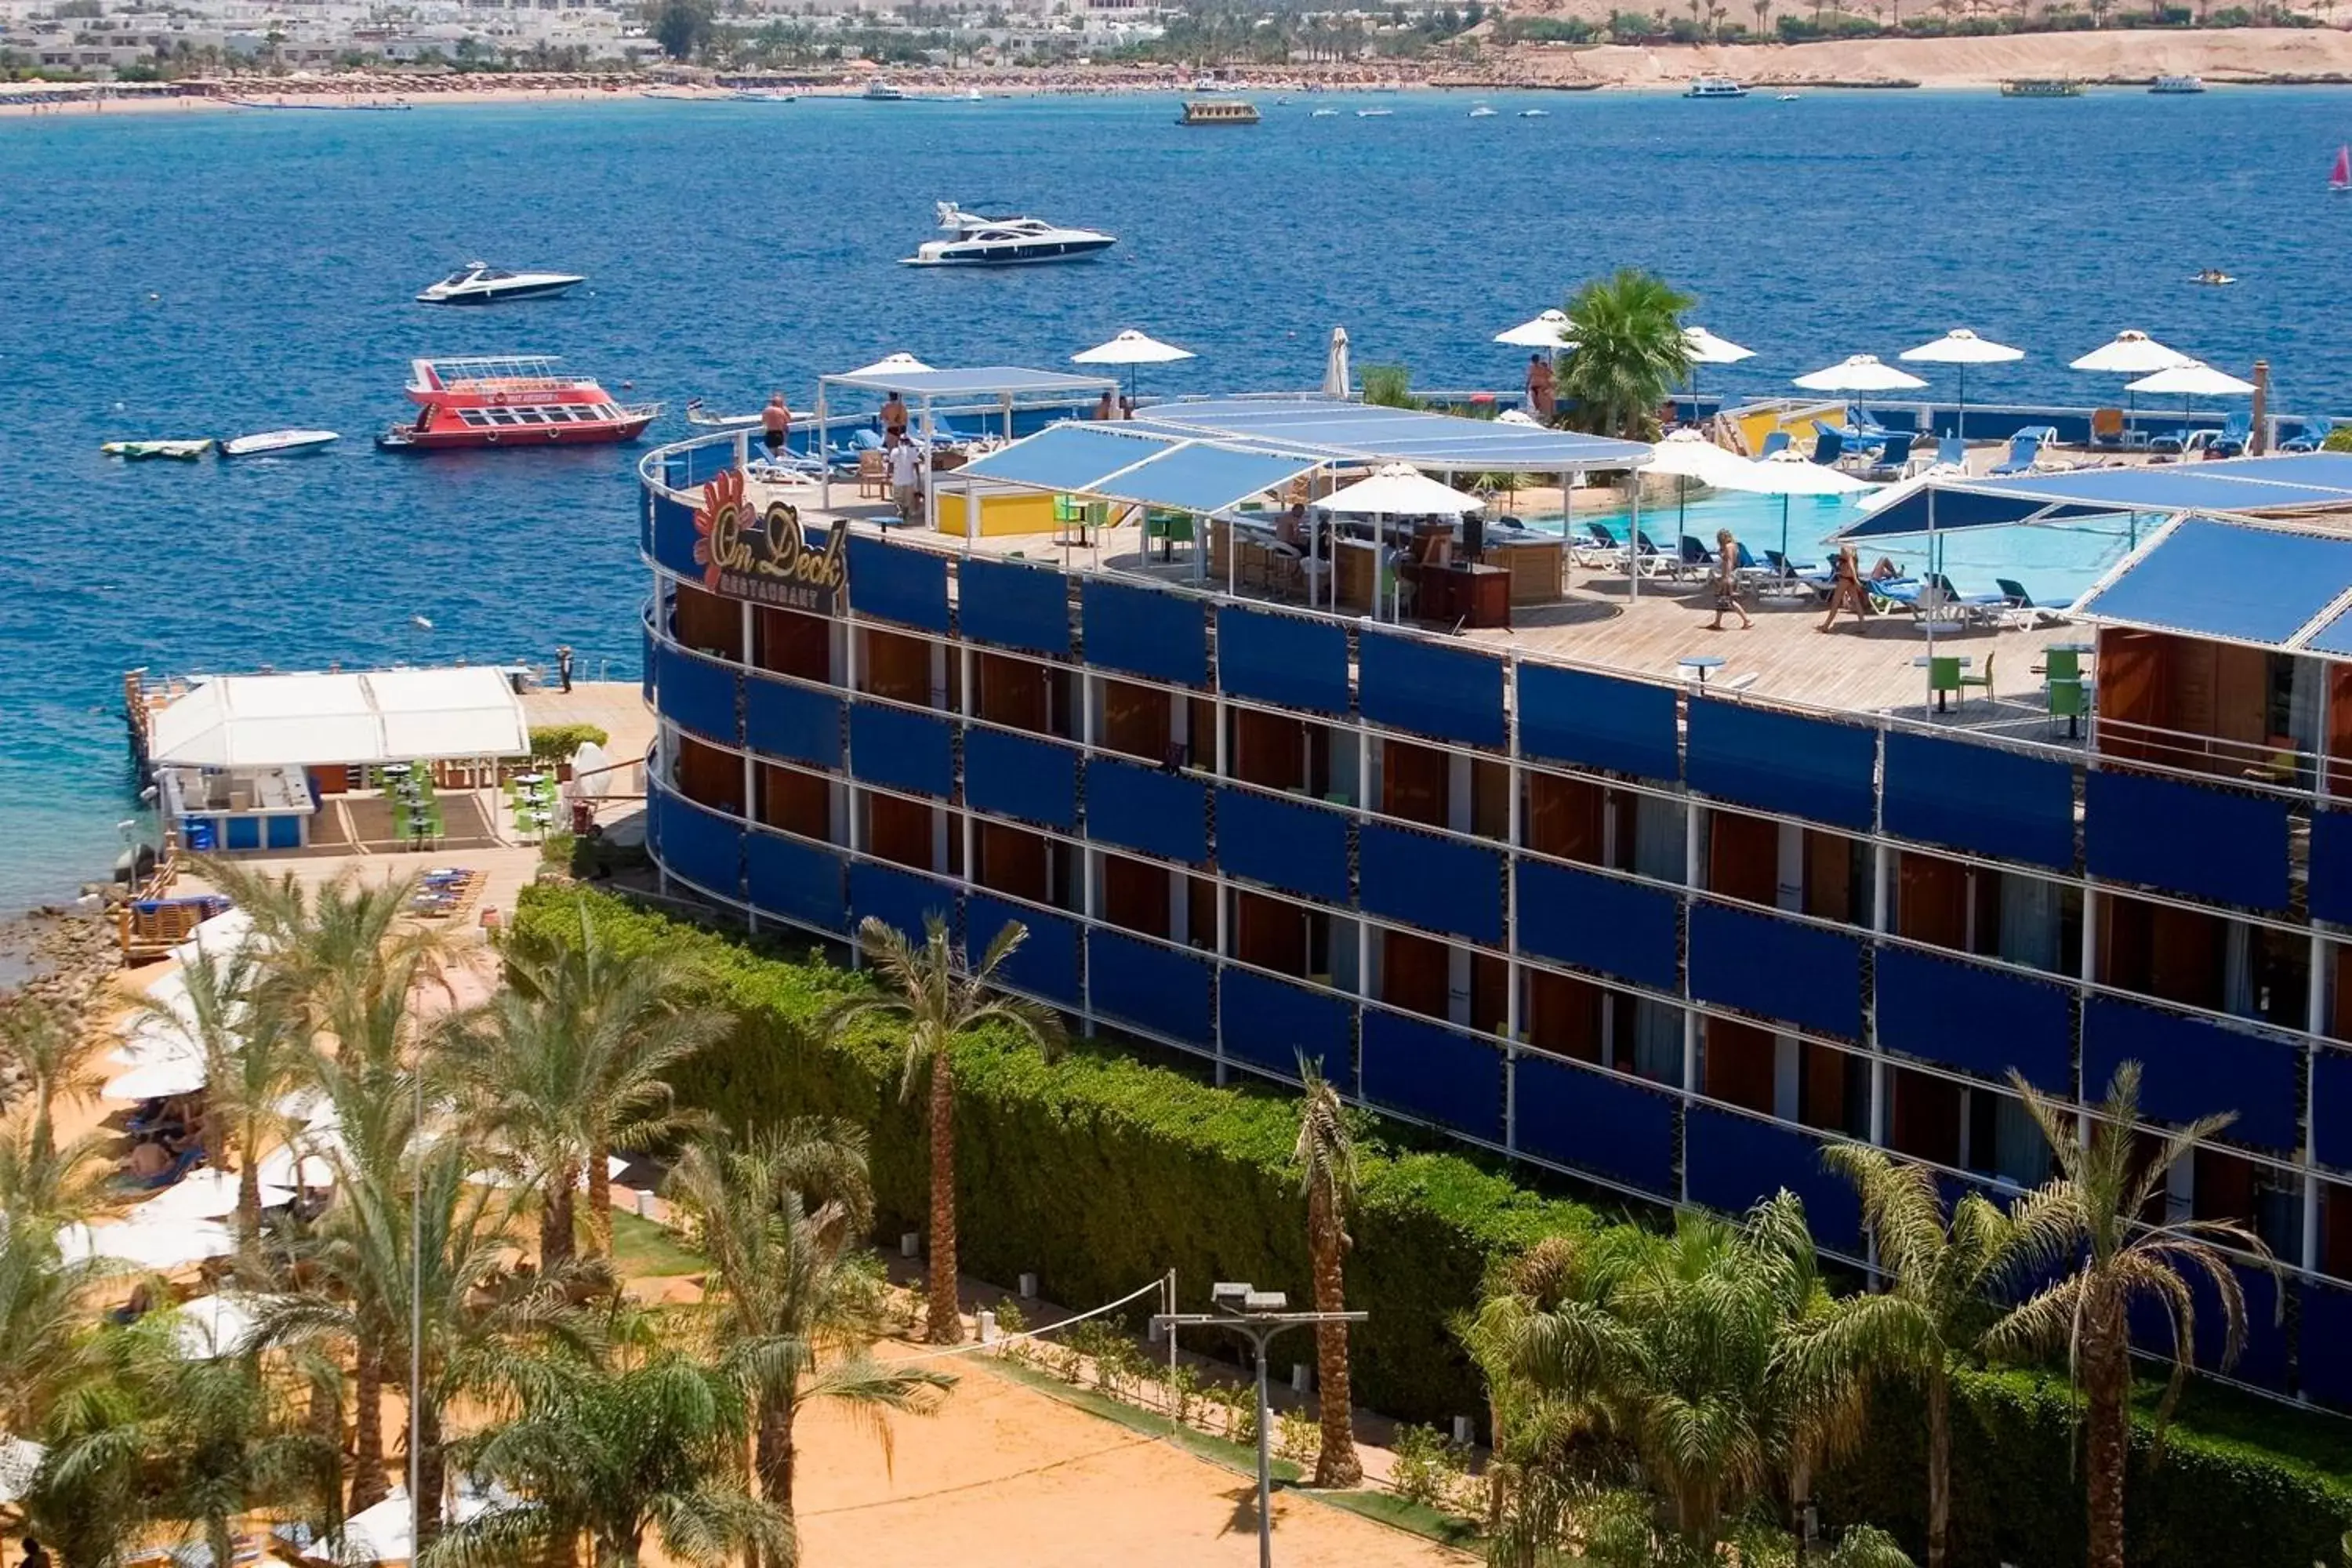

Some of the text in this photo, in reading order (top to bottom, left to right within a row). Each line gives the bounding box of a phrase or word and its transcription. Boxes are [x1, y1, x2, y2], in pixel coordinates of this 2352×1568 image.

[712, 503, 841, 587] On Deck
[721, 573, 818, 609] RESTAURANT
